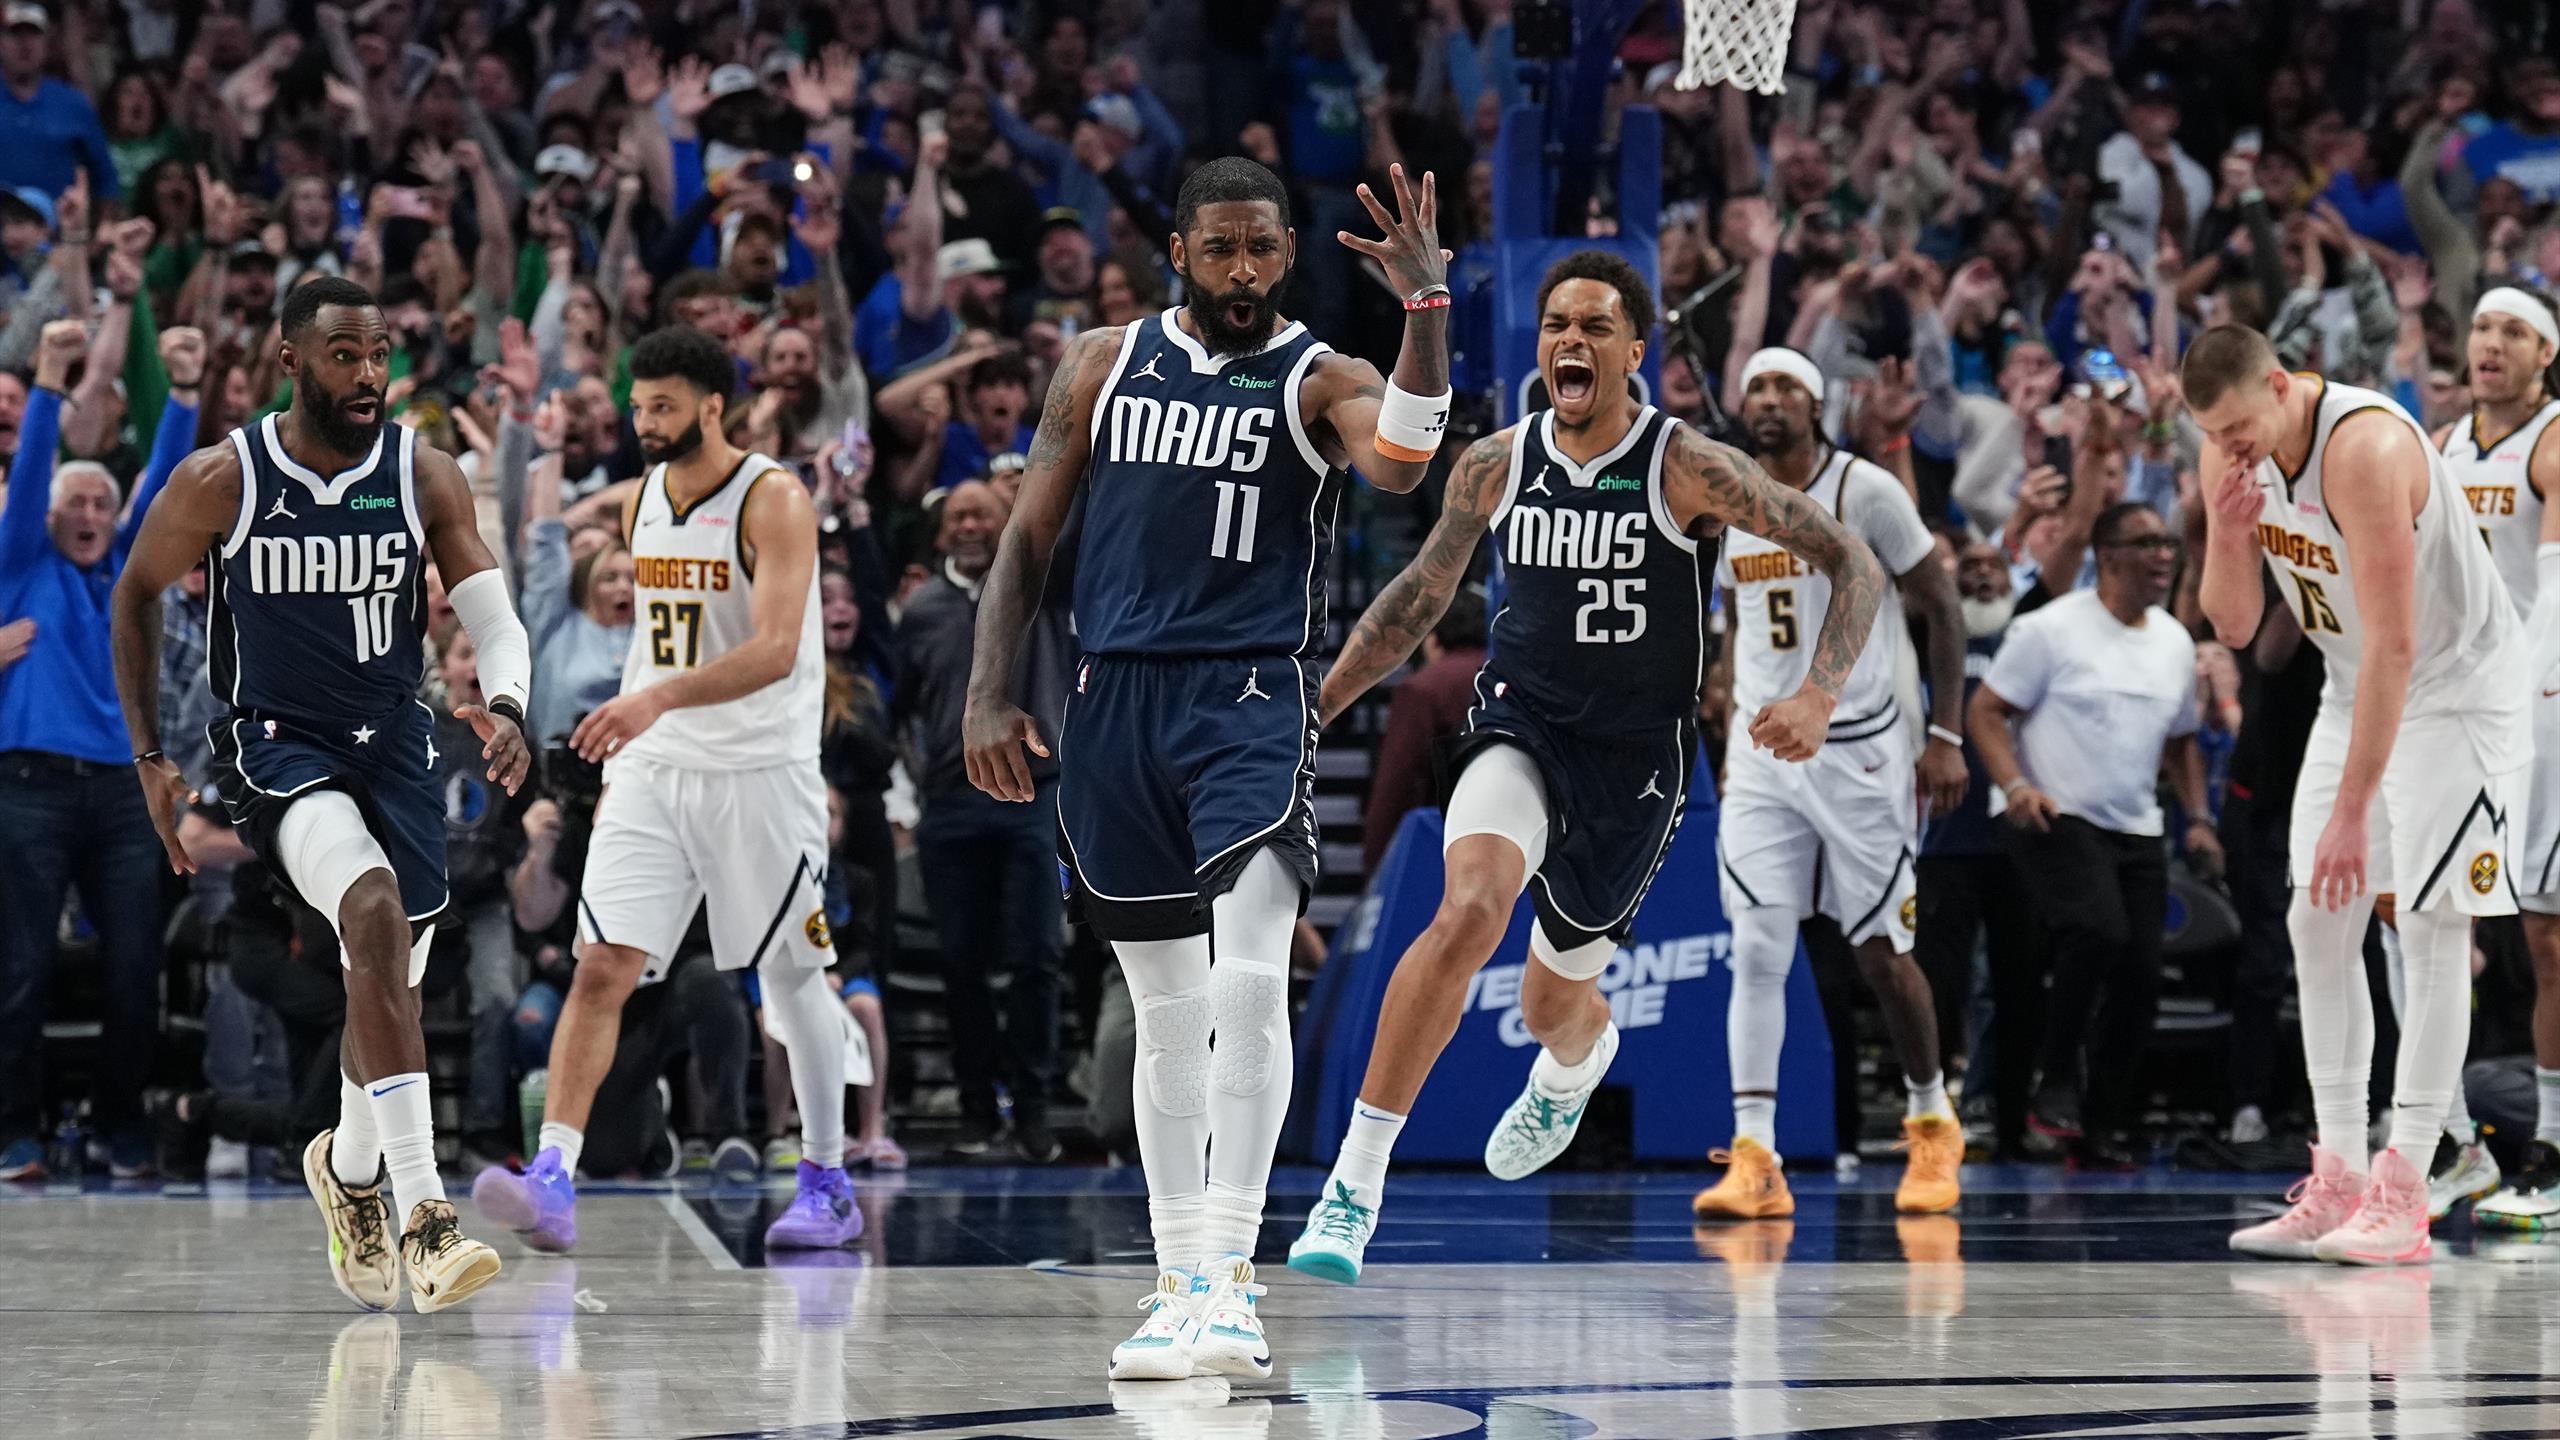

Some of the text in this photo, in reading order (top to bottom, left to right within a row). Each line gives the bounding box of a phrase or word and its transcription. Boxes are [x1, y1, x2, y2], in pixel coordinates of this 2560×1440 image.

[1411, 300, 1429, 309] KAI
[1228, 374, 1277, 389] chime
[1109, 395, 1276, 473] MAVS
[351, 495, 396, 510] chime
[1597, 475, 1641, 490] chime
[1210, 480, 1261, 563] 11
[1507, 504, 1648, 570] MAVS
[250, 532, 407, 594] MAVS
[347, 591, 399, 663] 10
[648, 600, 704, 668] 27
[1576, 578, 1647, 643] 25
[1767, 588, 1799, 650] 5
[2288, 570, 2342, 634] 15
